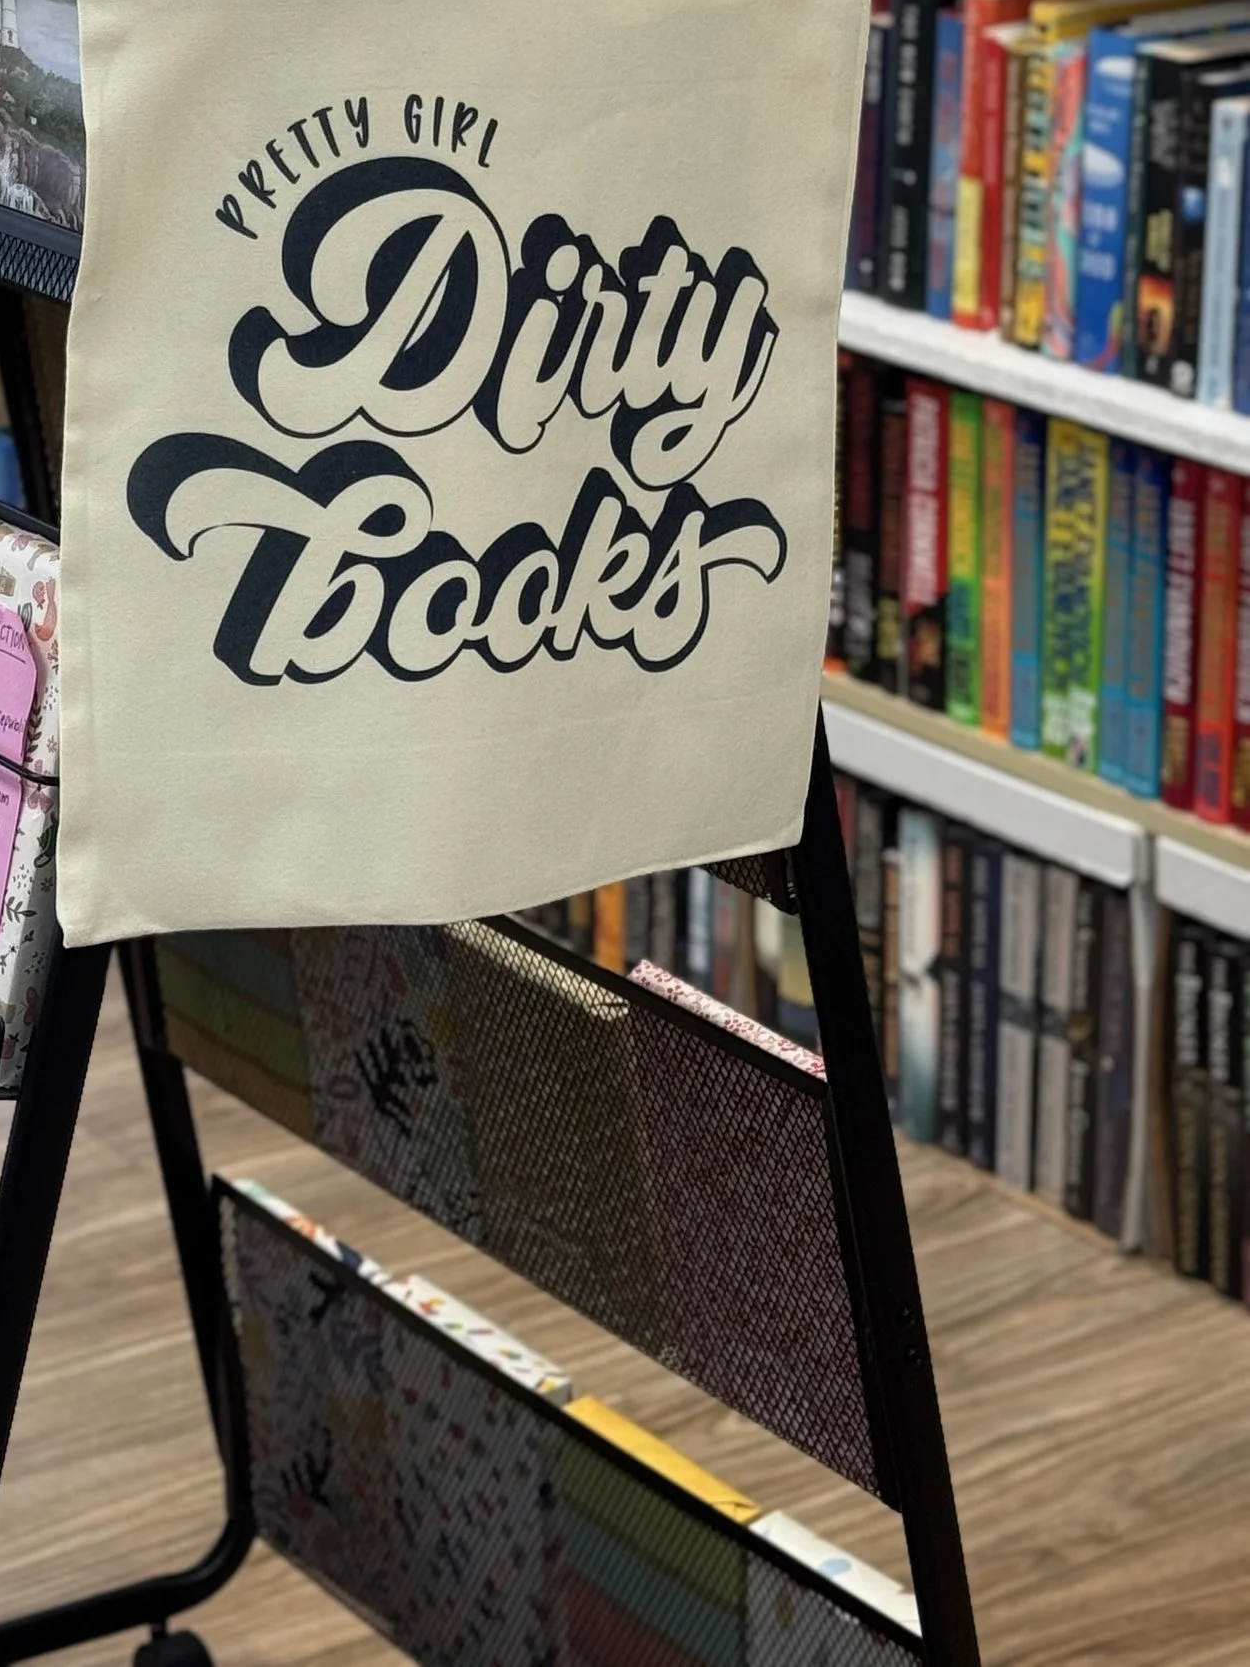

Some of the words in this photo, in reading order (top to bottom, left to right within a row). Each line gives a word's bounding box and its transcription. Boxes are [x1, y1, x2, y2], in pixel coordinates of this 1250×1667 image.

[215, 95, 369, 239] PRETTY
[404, 94, 500, 168] GIRL
[228, 155, 779, 492] Dirty
